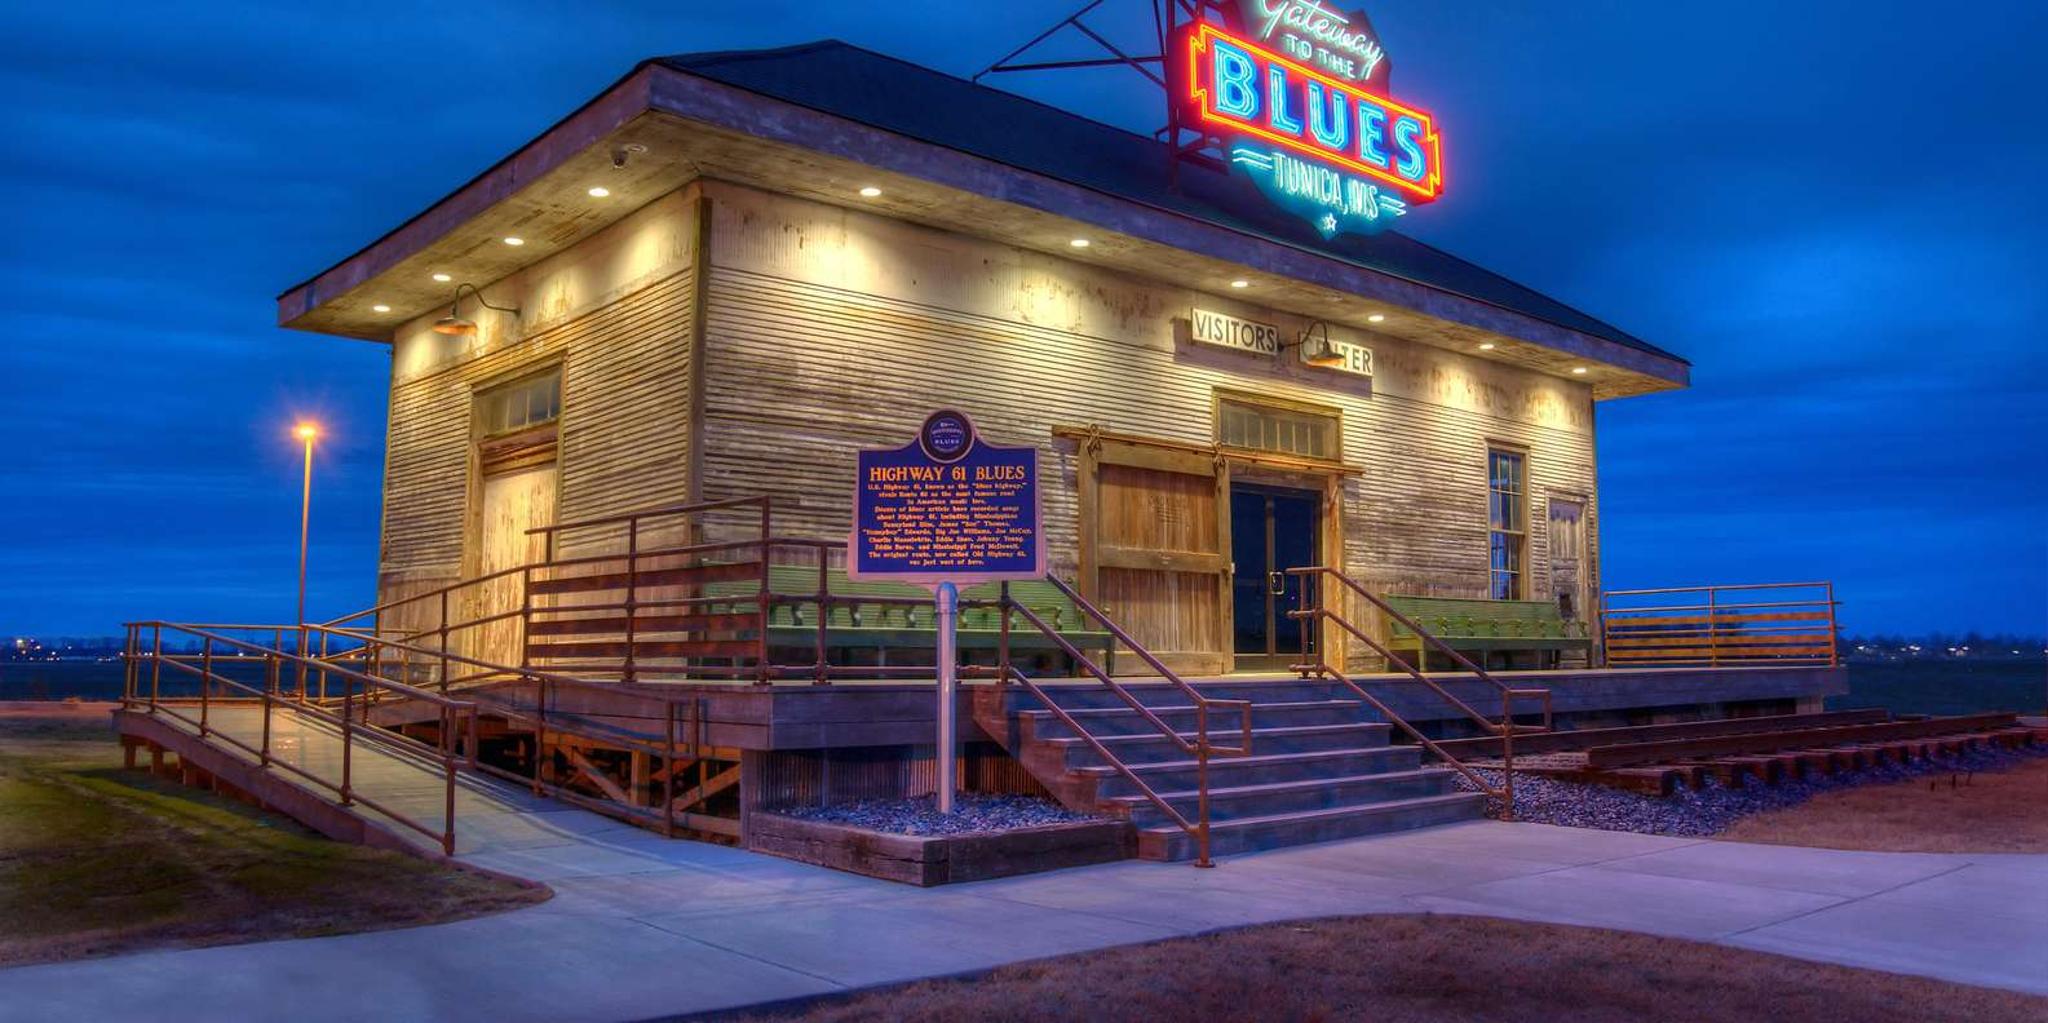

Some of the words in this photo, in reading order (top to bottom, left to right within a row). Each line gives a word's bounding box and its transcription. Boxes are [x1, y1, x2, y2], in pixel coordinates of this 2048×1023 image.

[1286, 34, 1313, 59] TO
[1320, 48, 1356, 79] THE
[1214, 41, 1426, 182] BLUES
[1272, 152, 1349, 216] TUNICA,
[1348, 178, 1379, 219] MS
[1194, 311, 1276, 352] VISITORS
[869, 467, 944, 481] HIGHWAY
[951, 466, 967, 481] 61
[976, 465, 1025, 480] BLUES
